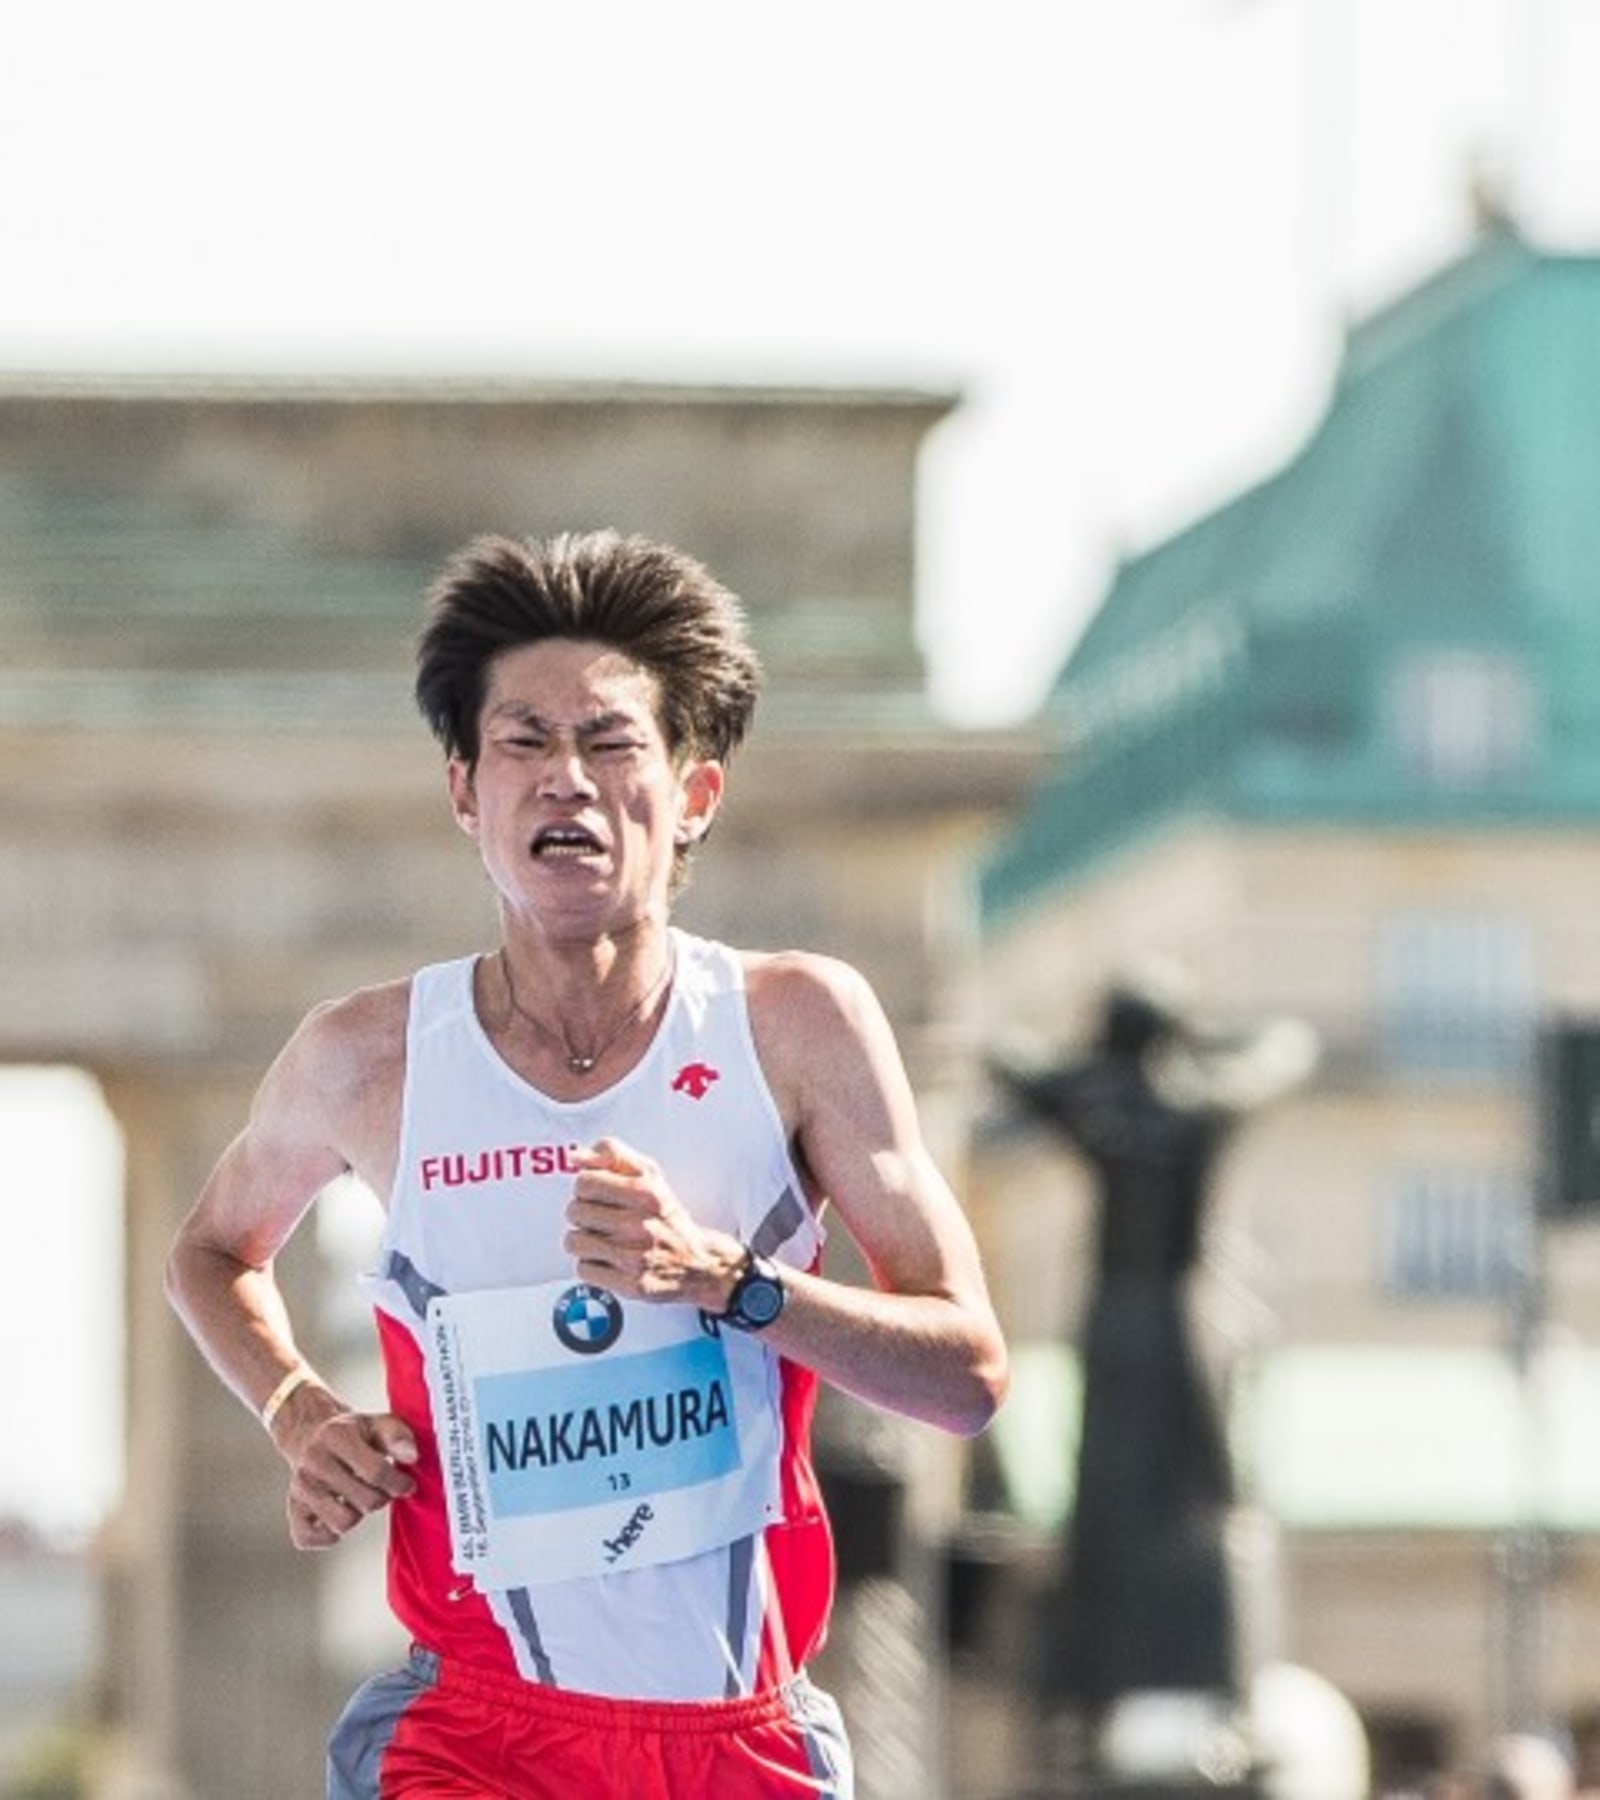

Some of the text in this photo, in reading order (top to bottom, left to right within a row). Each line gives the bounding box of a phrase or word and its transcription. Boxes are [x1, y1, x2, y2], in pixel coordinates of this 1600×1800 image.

[486, 1380, 729, 1473] NAKAMURA
[608, 1473, 631, 1490] 13
[603, 1502, 654, 1556] here
